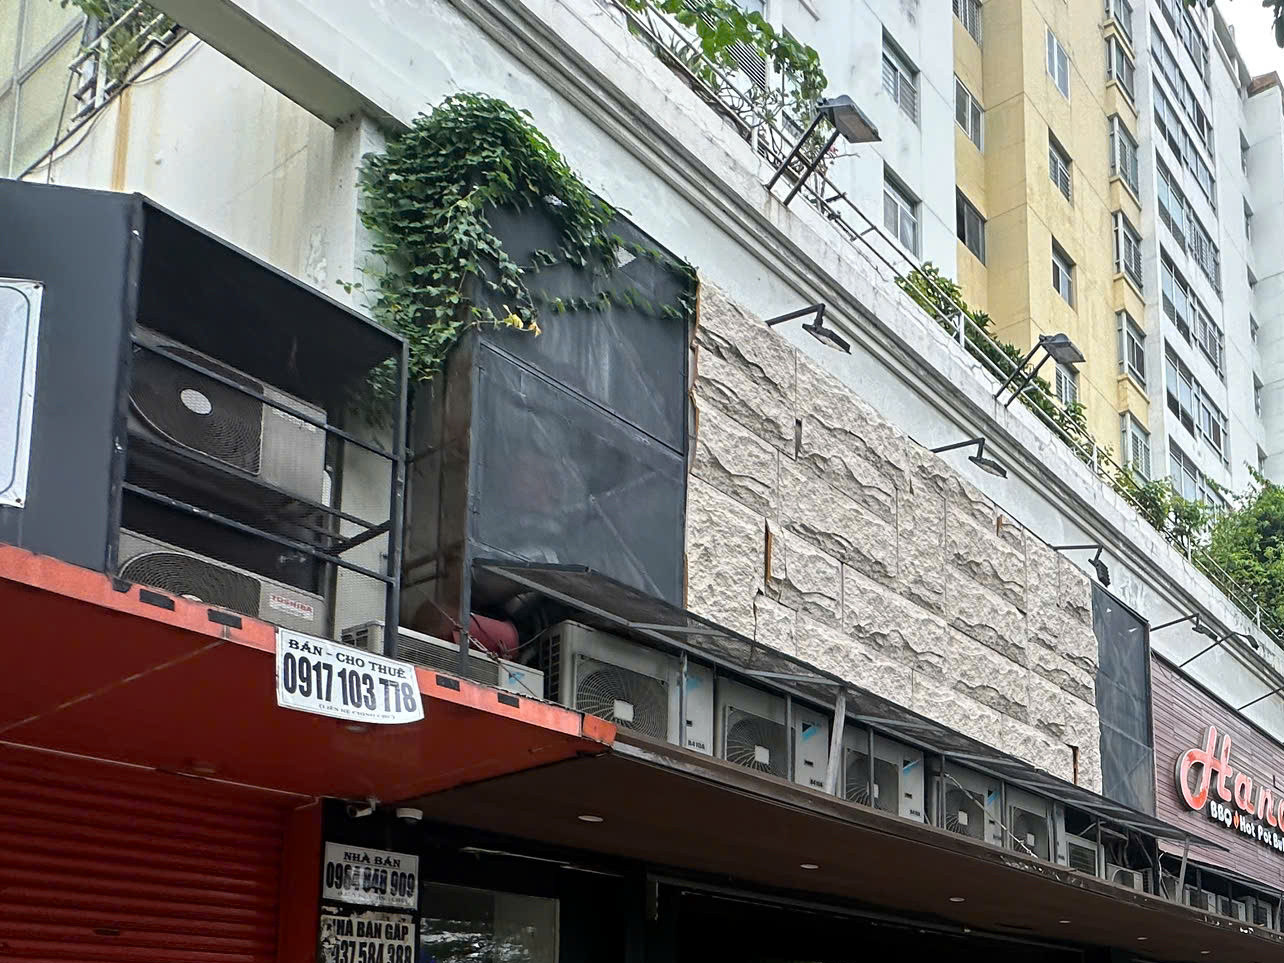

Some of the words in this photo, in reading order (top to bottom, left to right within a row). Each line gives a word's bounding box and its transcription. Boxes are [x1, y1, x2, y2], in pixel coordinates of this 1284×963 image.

[288, 638, 323, 656] BÁN
[336, 652, 365, 668] CHO
[368, 661, 406, 679] THUÊ
[283, 652, 333, 702] 0917
[337, 667, 377, 711] 103
[1210, 800, 1233, 827] BBQ
[1239, 815, 1256, 837] Hot
[1257, 825, 1272, 846] Pot
[374, 856, 401, 868] BÁN
[390, 870, 415, 898] 909
